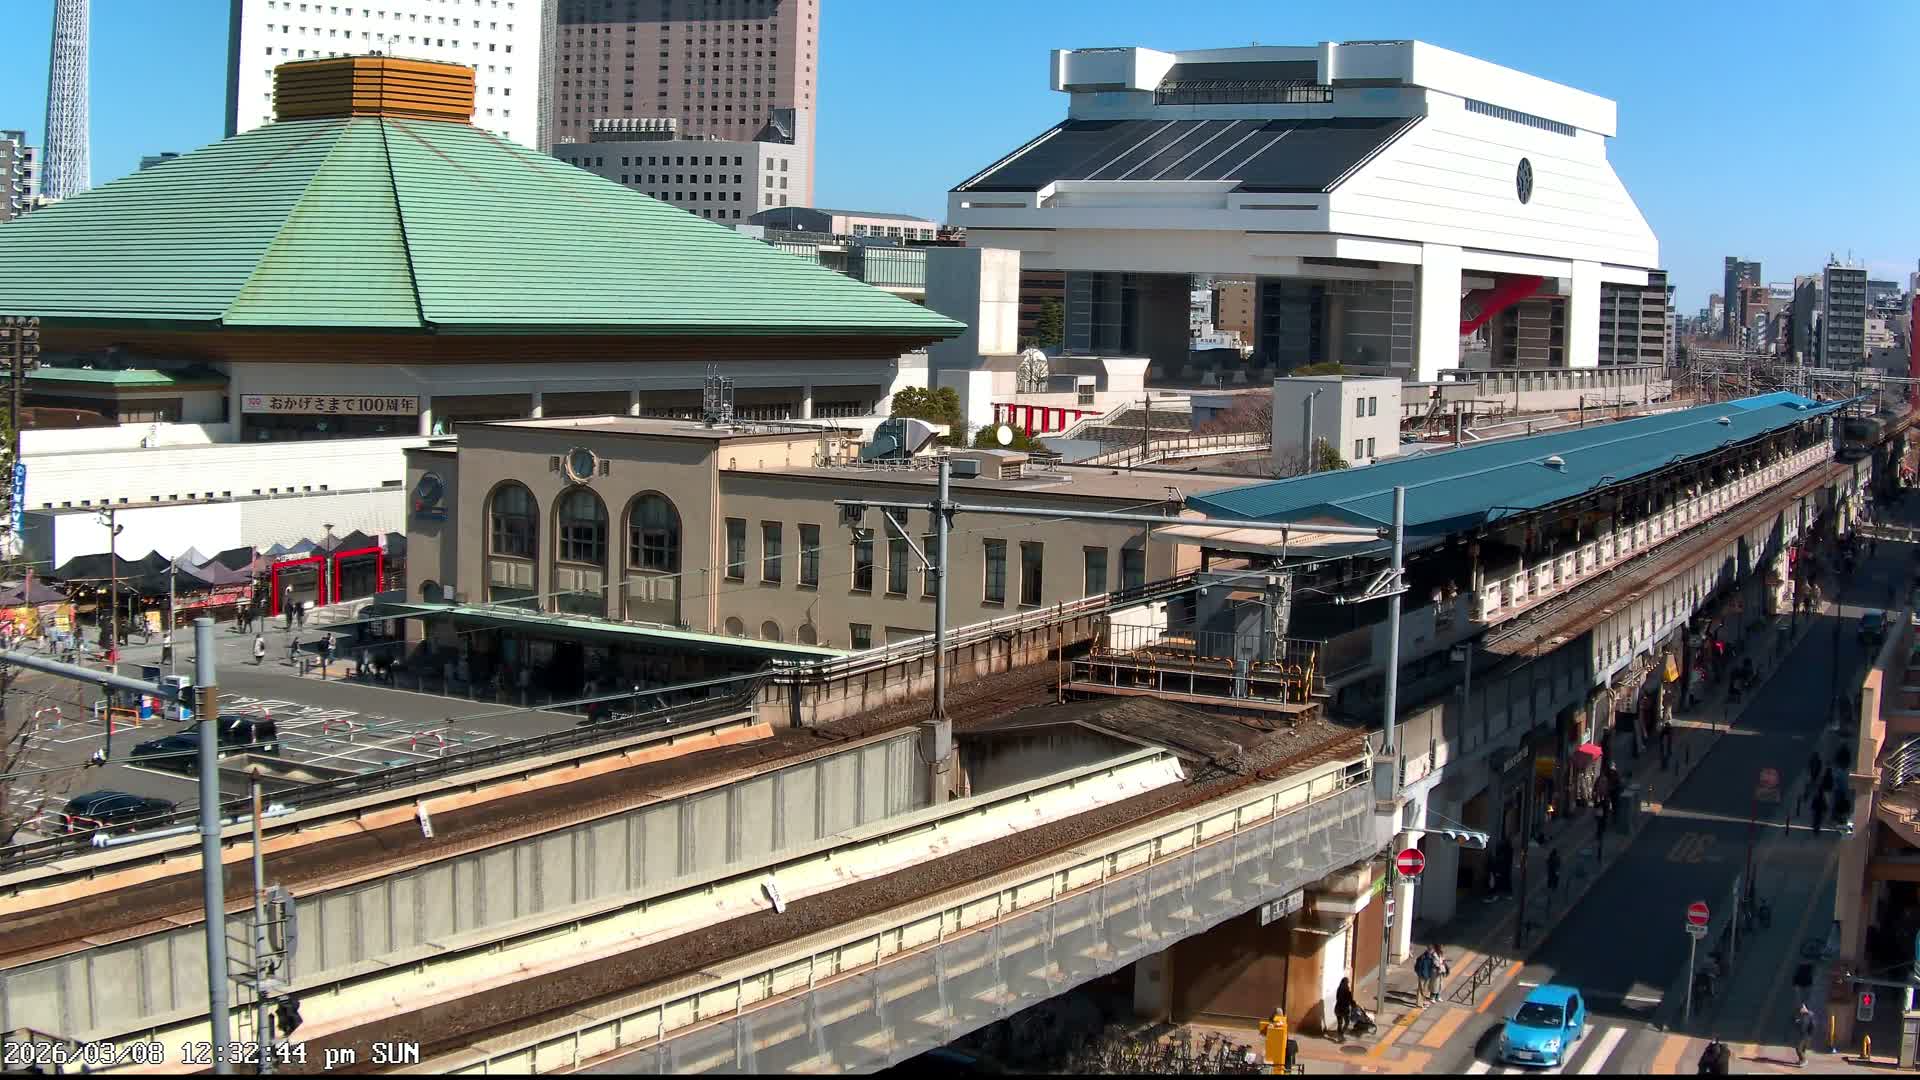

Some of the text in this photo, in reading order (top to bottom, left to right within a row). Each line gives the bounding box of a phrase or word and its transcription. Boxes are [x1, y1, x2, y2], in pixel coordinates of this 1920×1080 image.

[269, 397, 414, 413] おかげさまで100周年
